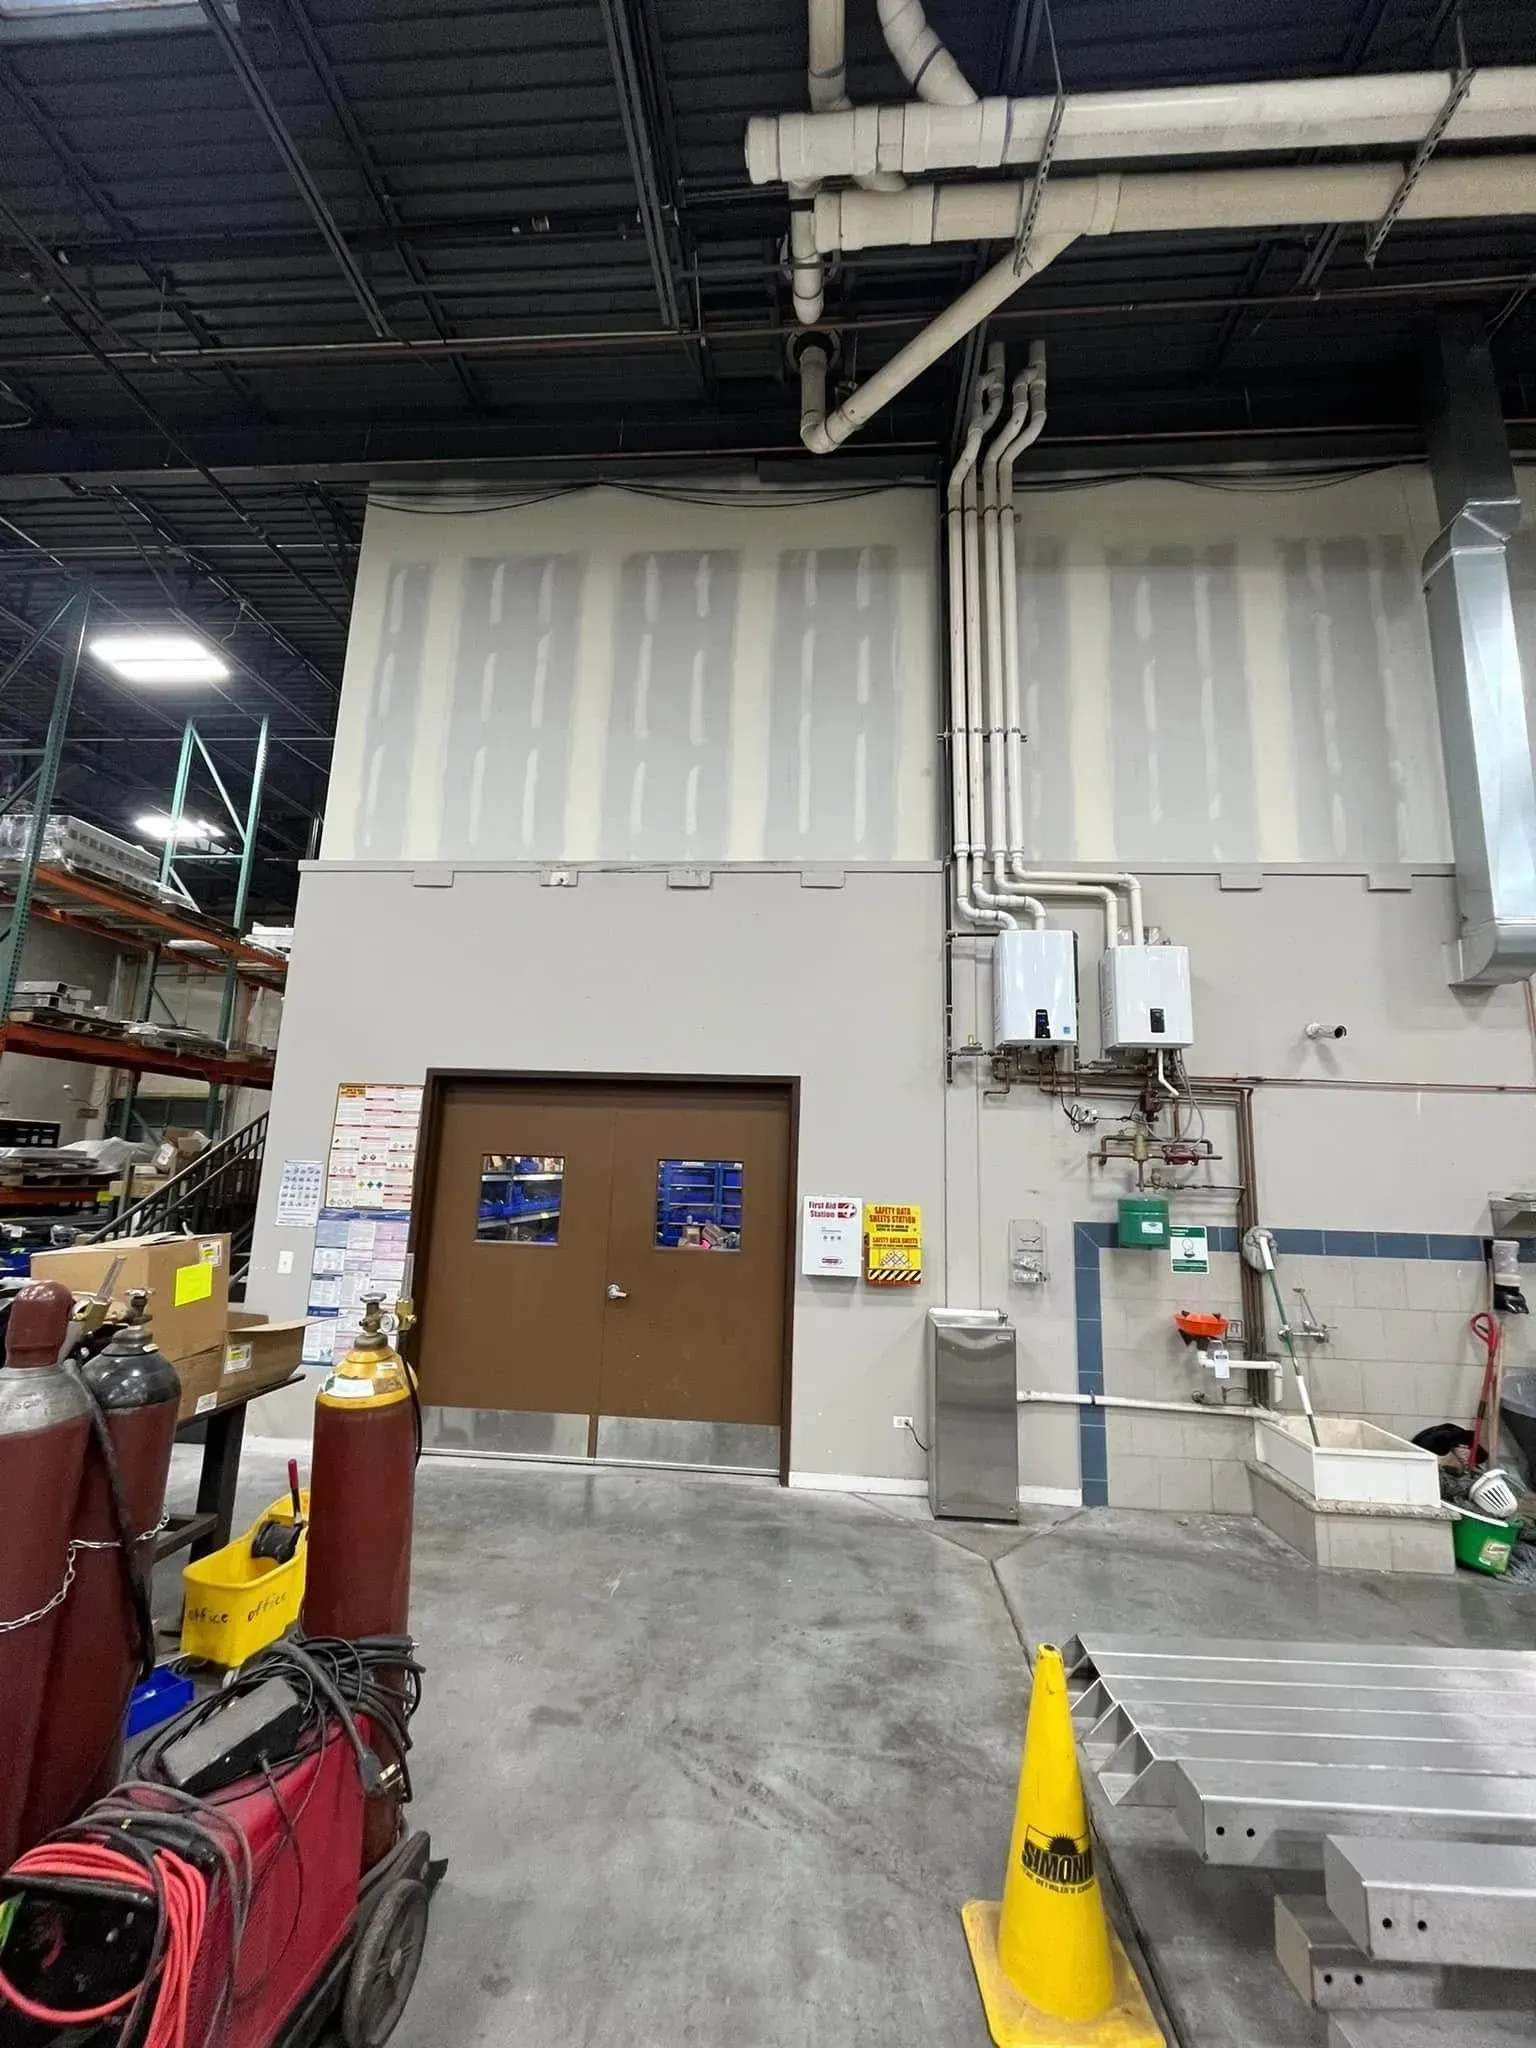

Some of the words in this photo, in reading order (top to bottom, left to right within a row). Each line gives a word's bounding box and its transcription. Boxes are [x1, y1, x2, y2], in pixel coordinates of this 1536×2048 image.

[808, 1201, 824, 1209] First
[825, 1201, 837, 1209] Aid
[810, 1210, 835, 1218] Station
[874, 1206, 895, 1214] SAFETY
[896, 1207, 911, 1215] DATA
[869, 1214, 891, 1223] SHEETS
[891, 1216, 916, 1224] STATION
[247, 1591, 287, 1622] office
[1022, 1843, 1094, 1883] SIMONI
